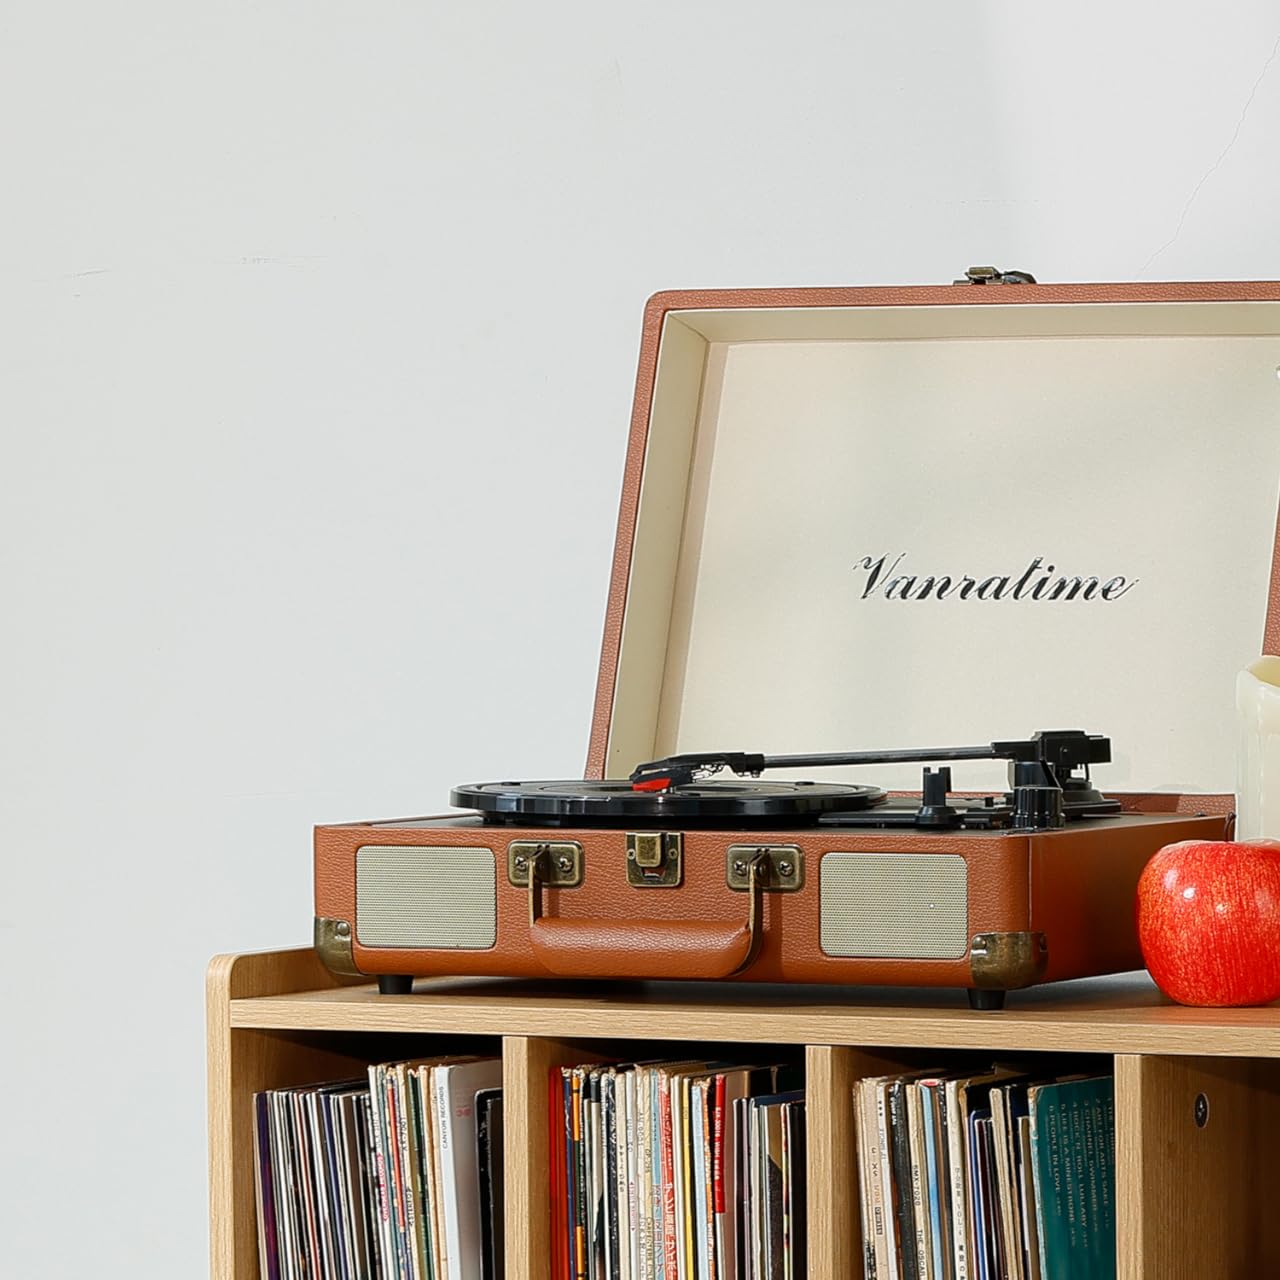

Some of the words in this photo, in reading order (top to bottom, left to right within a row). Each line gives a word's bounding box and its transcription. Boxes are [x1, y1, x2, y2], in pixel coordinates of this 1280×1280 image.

[852, 551, 1139, 601] Vanratime
[438, 1086, 446, 1118] RECORDS
[917, 1249, 926, 1277] OSCAR
